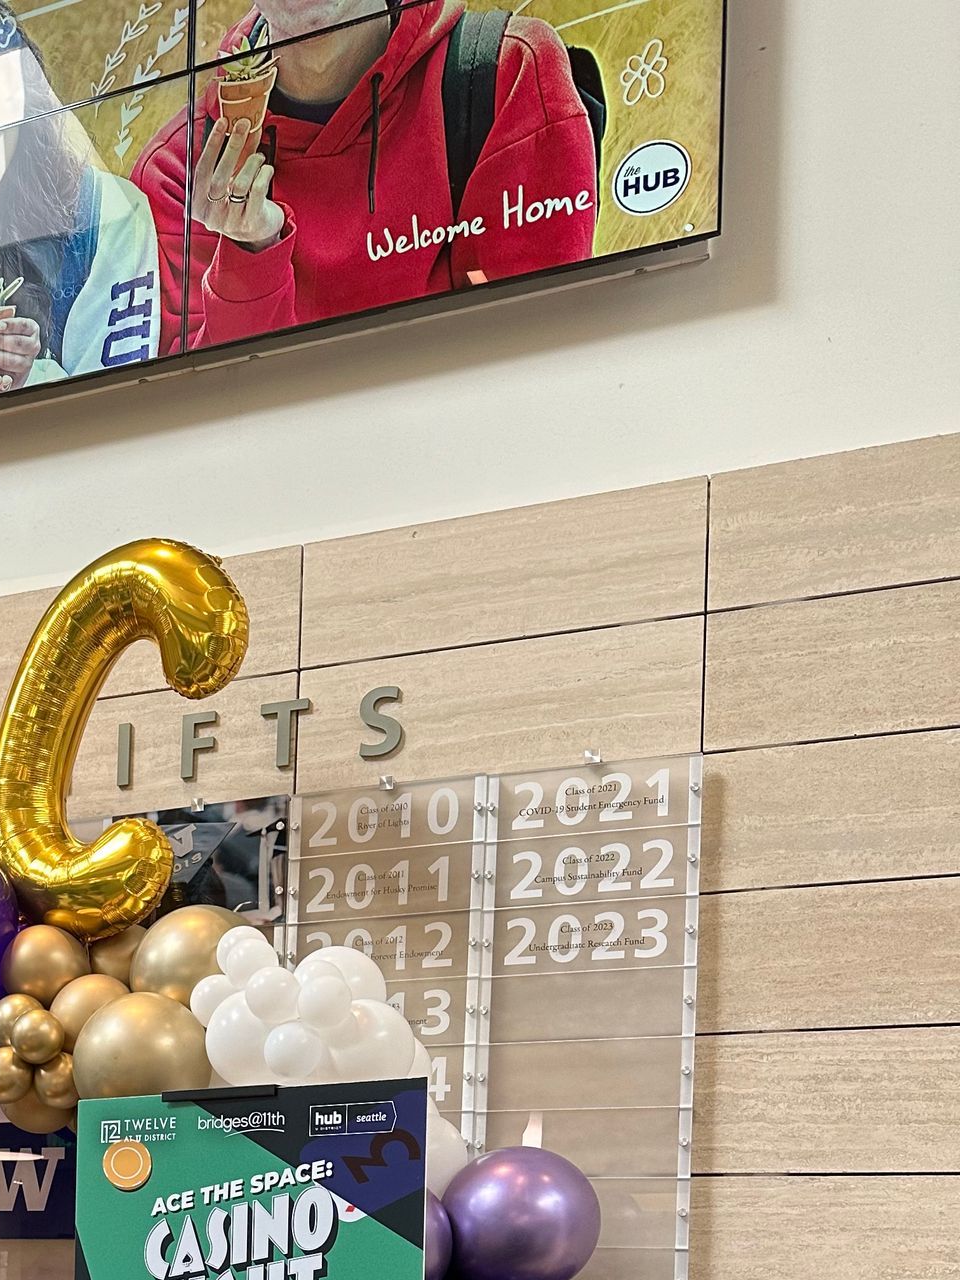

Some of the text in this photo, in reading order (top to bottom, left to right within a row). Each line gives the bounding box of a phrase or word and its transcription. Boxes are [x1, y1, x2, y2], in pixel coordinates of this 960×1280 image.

[622, 167, 680, 198] HUB
[624, 165, 641, 178] the
[367, 184, 593, 262] Welcome Home
[116, 685, 403, 789] IFTS
[512, 768, 670, 830] 2021
[565, 787, 586, 796] Class
[519, 795, 664, 817] COVID-19 Student Emergency Fund
[308, 788, 459, 848] 2010
[510, 839, 674, 899] 2022
[562, 855, 583, 865] Class
[306, 856, 450, 913] 2011
[534, 875, 567, 885] Campus
[621, 867, 643, 876] Fund
[326, 889, 370, 899] Endowment
[383, 886, 407, 896] Husky
[408, 884, 438, 893] Promise
[503, 908, 669, 966] 2023
[560, 924, 581, 933] Class
[624, 937, 645, 946] Fund
[124, 1116, 177, 1131] TWELVE
[197, 1111, 286, 1133] bridges@11th
[315, 1111, 387, 1126] hub seattle
[145, 1133, 176, 1143] DISTRICT
[151, 1160, 334, 1217] ACE THE SPACE:
